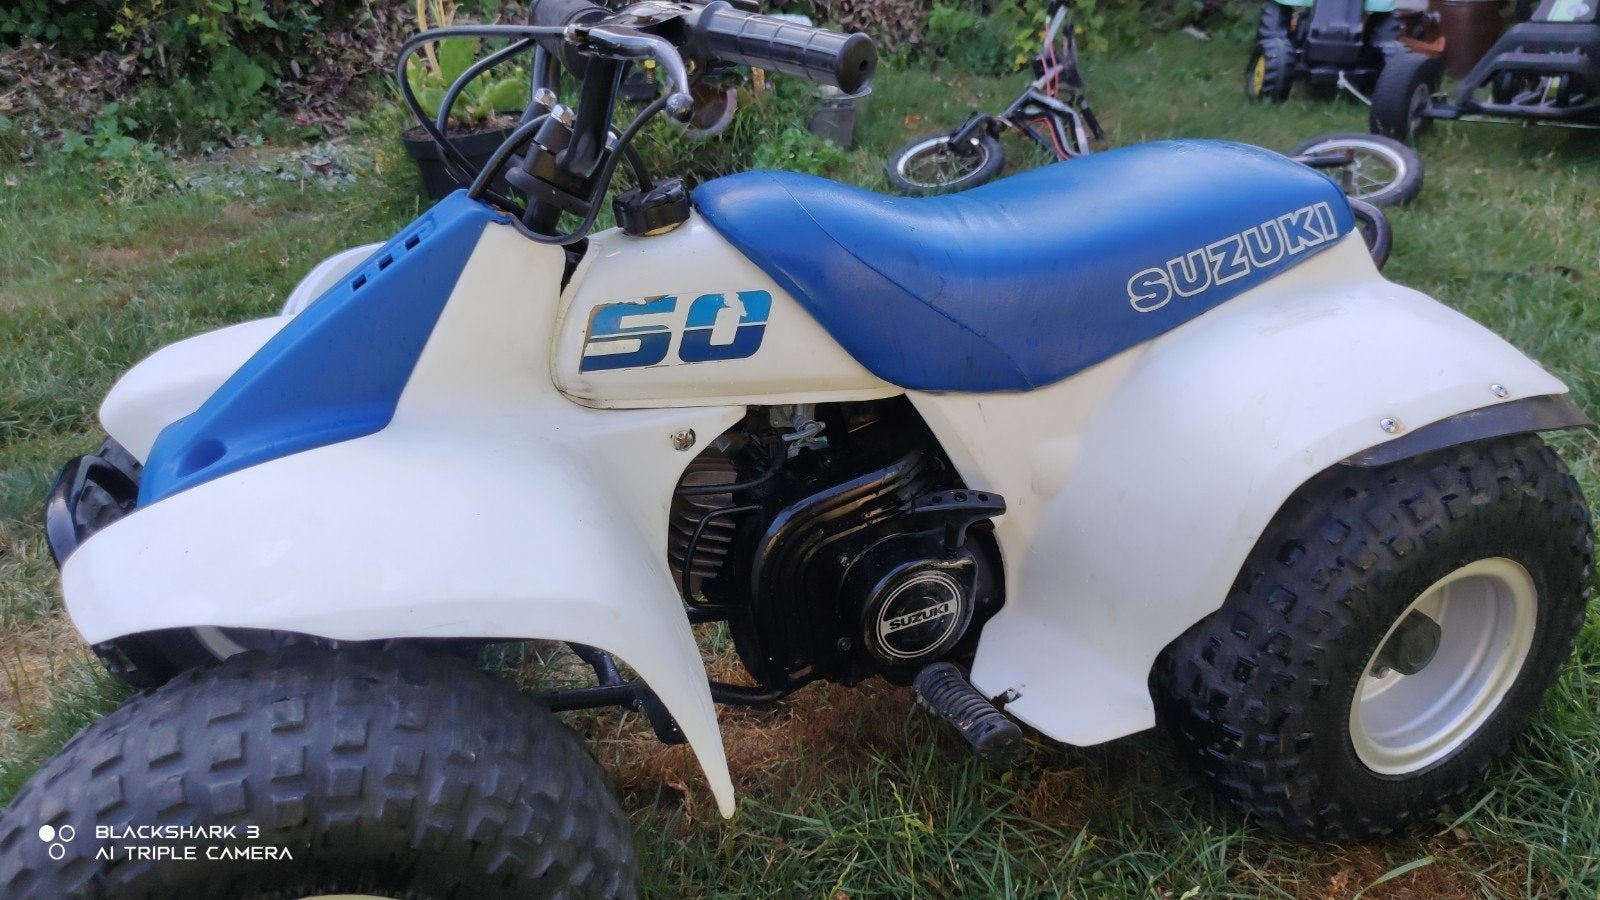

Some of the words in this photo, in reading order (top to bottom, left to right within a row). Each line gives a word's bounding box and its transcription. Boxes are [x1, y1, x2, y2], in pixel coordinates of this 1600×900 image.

[1126, 201, 1338, 313] SUZUKI
[579, 289, 773, 374] 50
[889, 603, 949, 630] SUZUKI
